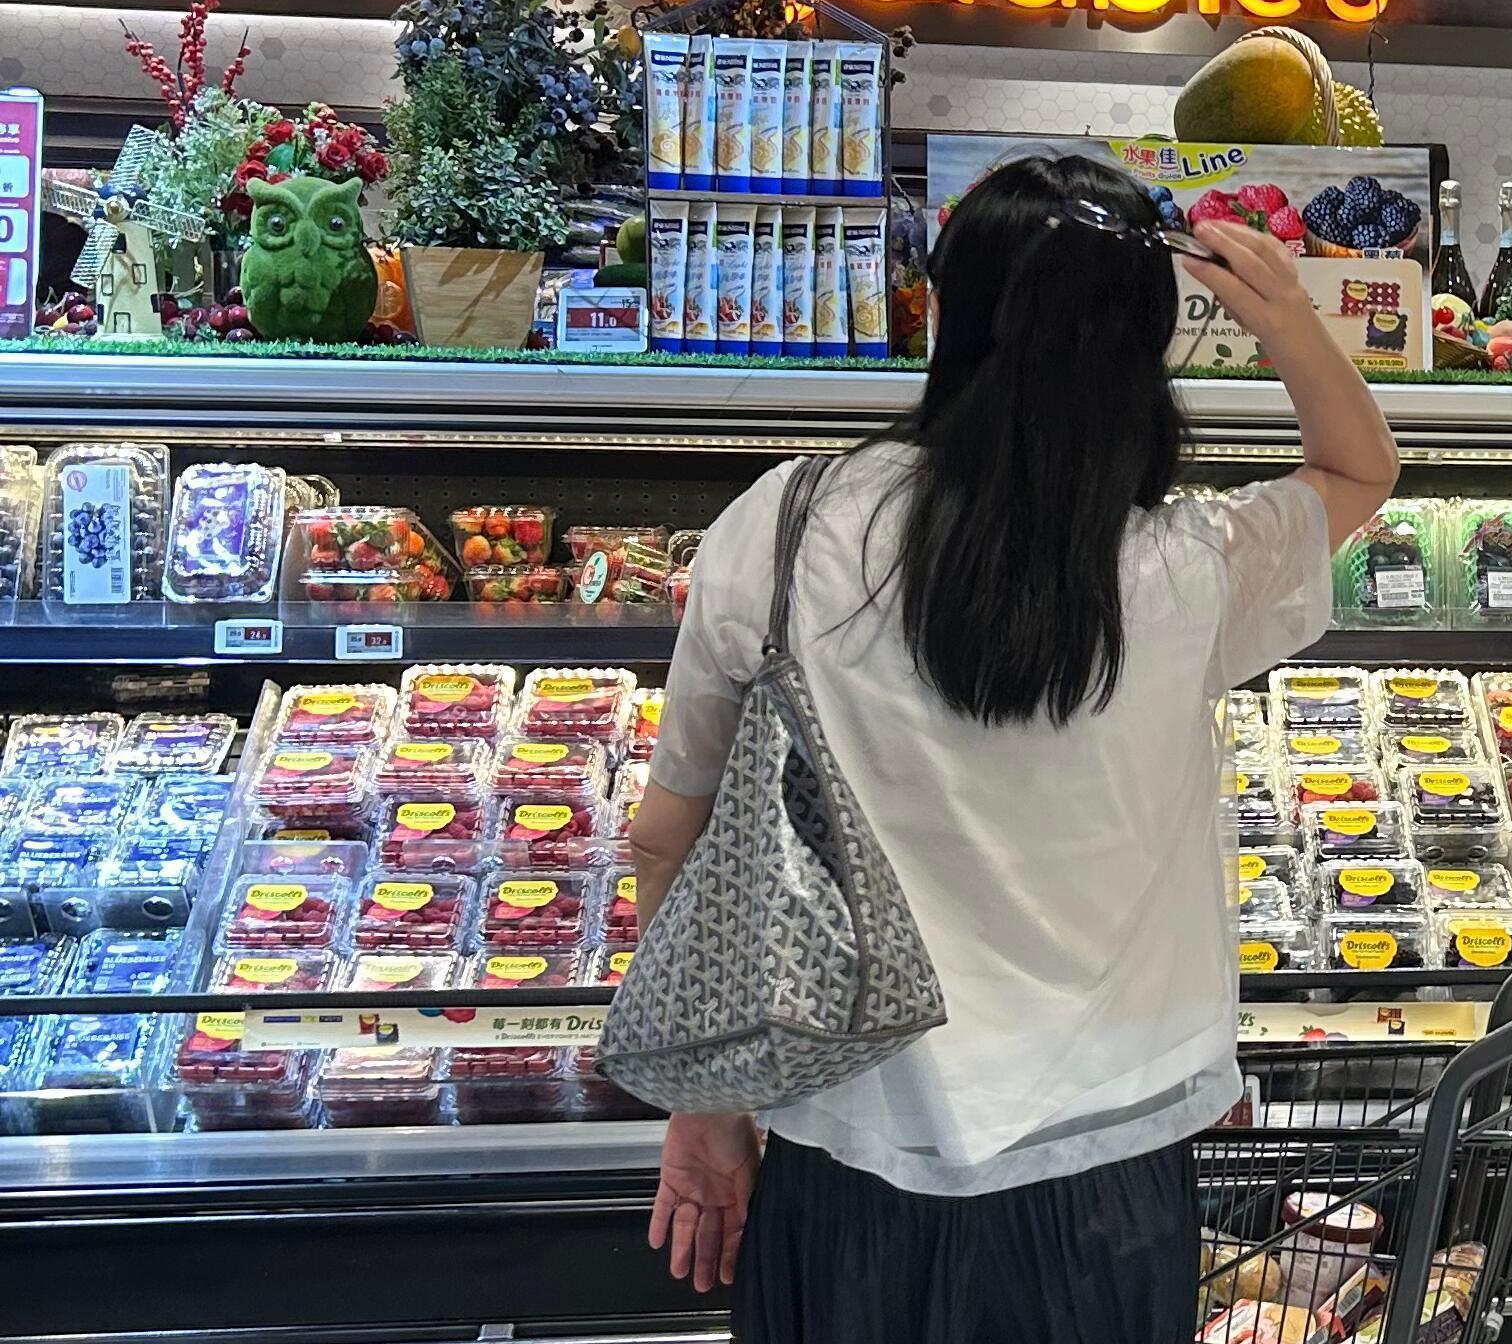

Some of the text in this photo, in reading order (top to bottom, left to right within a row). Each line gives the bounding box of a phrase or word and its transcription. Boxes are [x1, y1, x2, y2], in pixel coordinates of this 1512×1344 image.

[1123, 145, 1246, 177] 水果佳 Line
[590, 312, 617, 327] 11.0
[1174, 327, 1251, 337] ONE'S NATUR
[422, 680, 472, 691] Driscoll's
[400, 808, 450, 818] Driscoll's
[518, 809, 568, 819] Driscoll's
[1345, 874, 1387, 882] Driscoll's
[250, 888, 303, 899] Driscoll's
[377, 887, 429, 898] Driscoll's
[502, 886, 553, 896] Driscoll's
[1346, 940, 1390, 951] Driscoll's
[1462, 935, 1506, 946] Driscoll's
[1240, 952, 1272, 962] iscoll's
[239, 962, 293, 972] Driscoll's
[490, 960, 543, 970] Driscoll's
[201, 1015, 244, 1025] Drisco
